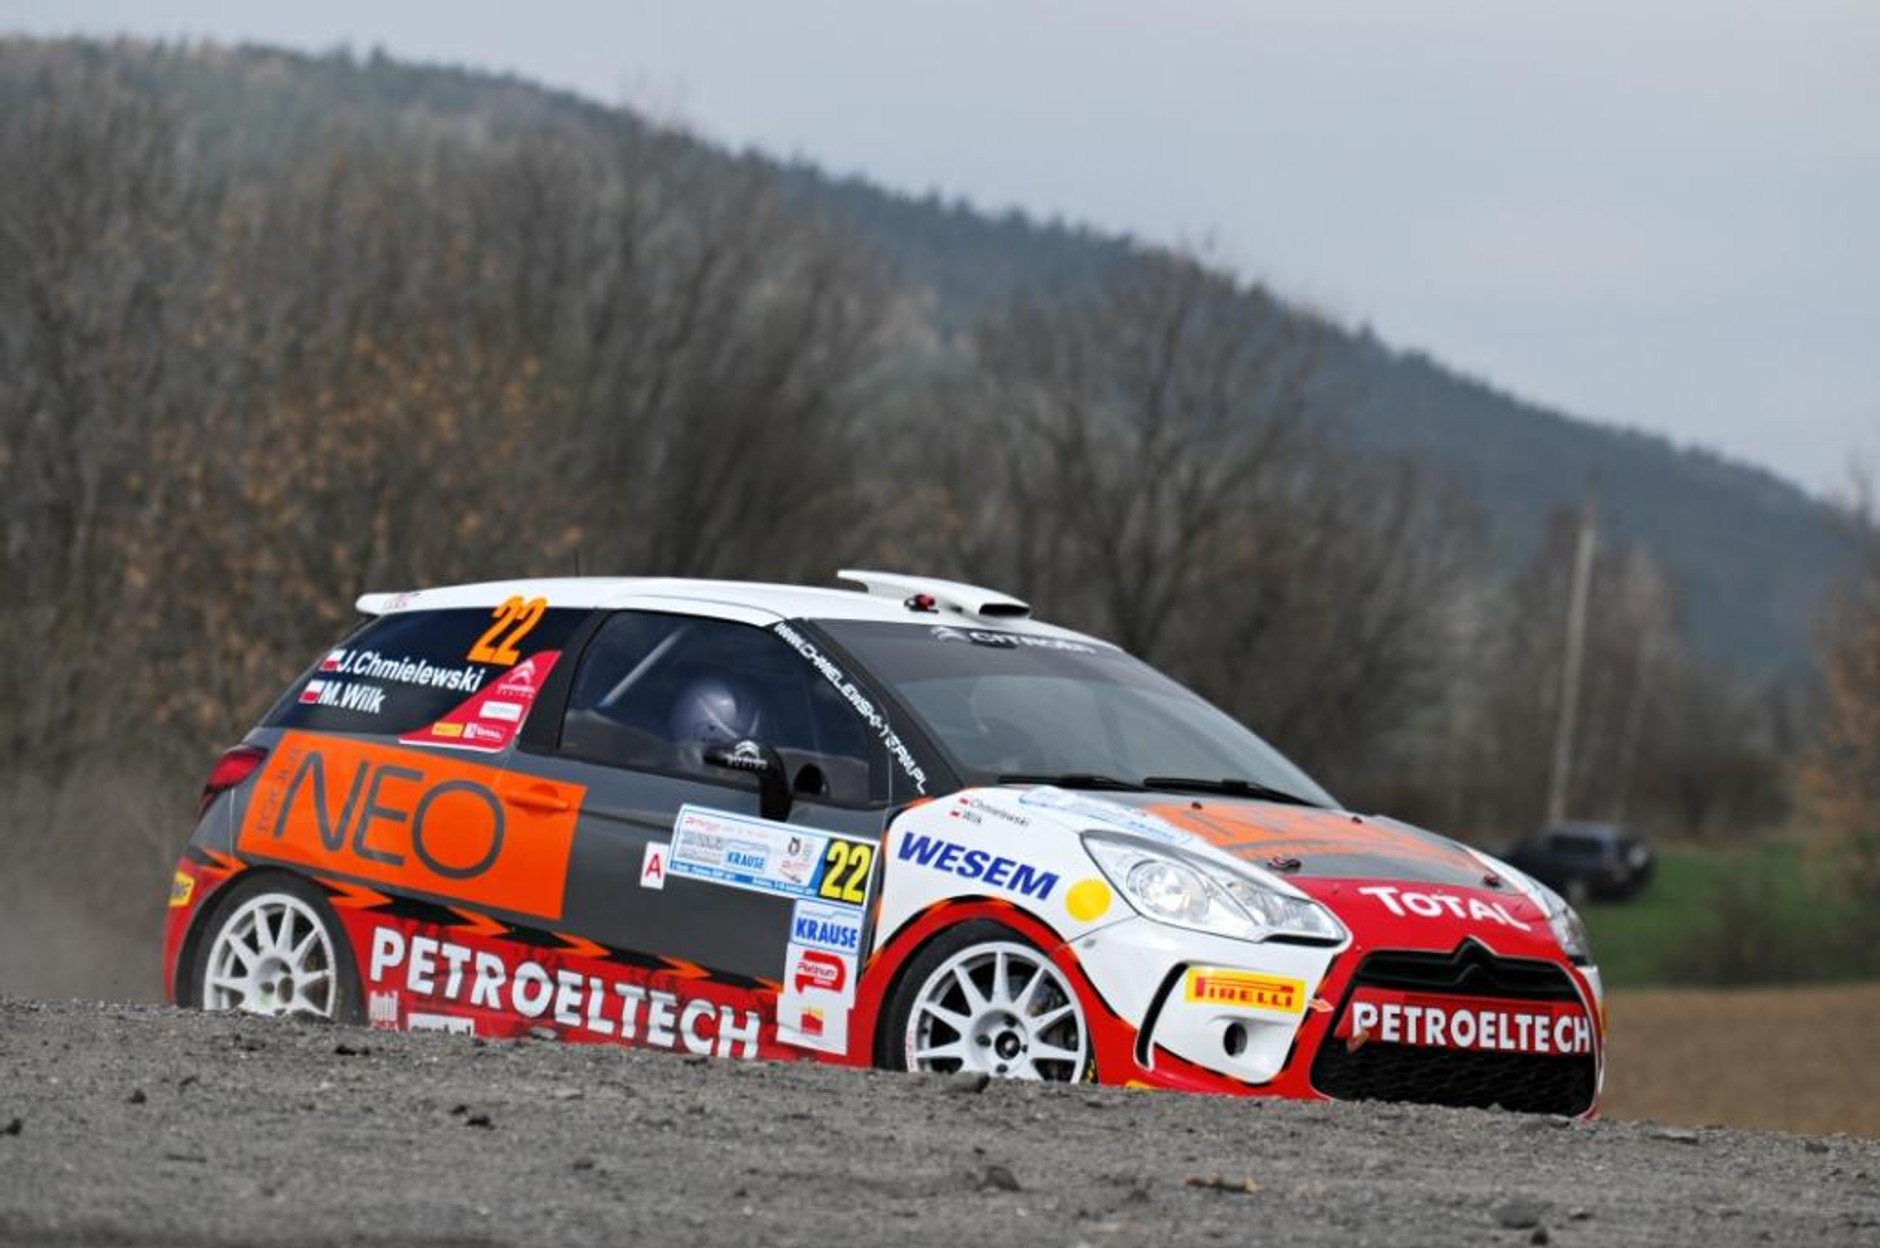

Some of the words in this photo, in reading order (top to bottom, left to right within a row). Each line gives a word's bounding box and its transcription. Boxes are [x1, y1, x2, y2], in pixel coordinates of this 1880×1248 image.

[467, 595, 548, 666] 22
[336, 649, 486, 693] J.Chmielewski
[318, 682, 386, 714] M.Wilk
[274, 750, 506, 879] NEO
[646, 853, 662, 880] A
[726, 850, 766, 870] KRAUSE
[820, 842, 872, 903] 22
[897, 831, 1060, 902] WESEM
[1358, 885, 1531, 932] TOTAL
[795, 918, 859, 950] KRAUSE
[369, 926, 761, 1059] PETROELTECH
[1194, 976, 1295, 1008] PIRELLI
[1352, 1002, 1591, 1053] PETROELTECH
